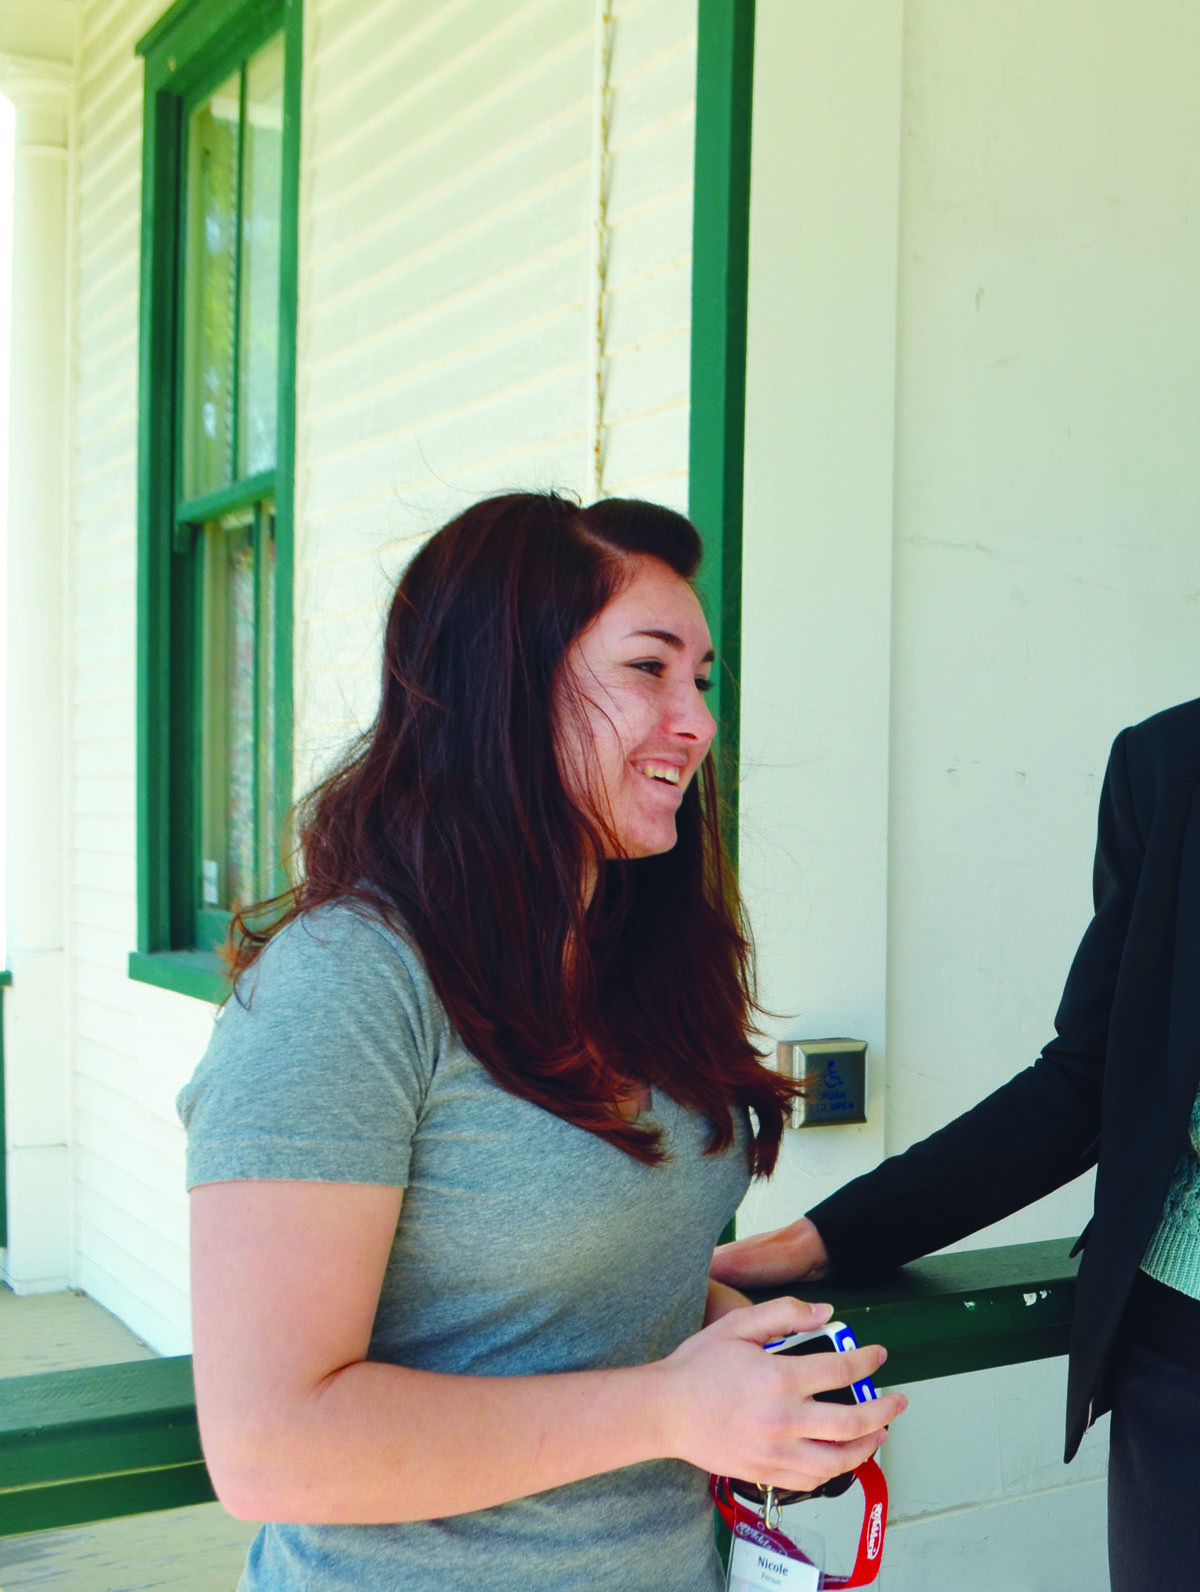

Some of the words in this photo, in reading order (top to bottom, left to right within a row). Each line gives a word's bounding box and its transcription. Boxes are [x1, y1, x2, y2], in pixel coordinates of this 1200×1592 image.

[822, 1091, 847, 1100] PUSH
[831, 1102, 855, 1111] OPEN
[758, 1556, 788, 1576] Nicole
